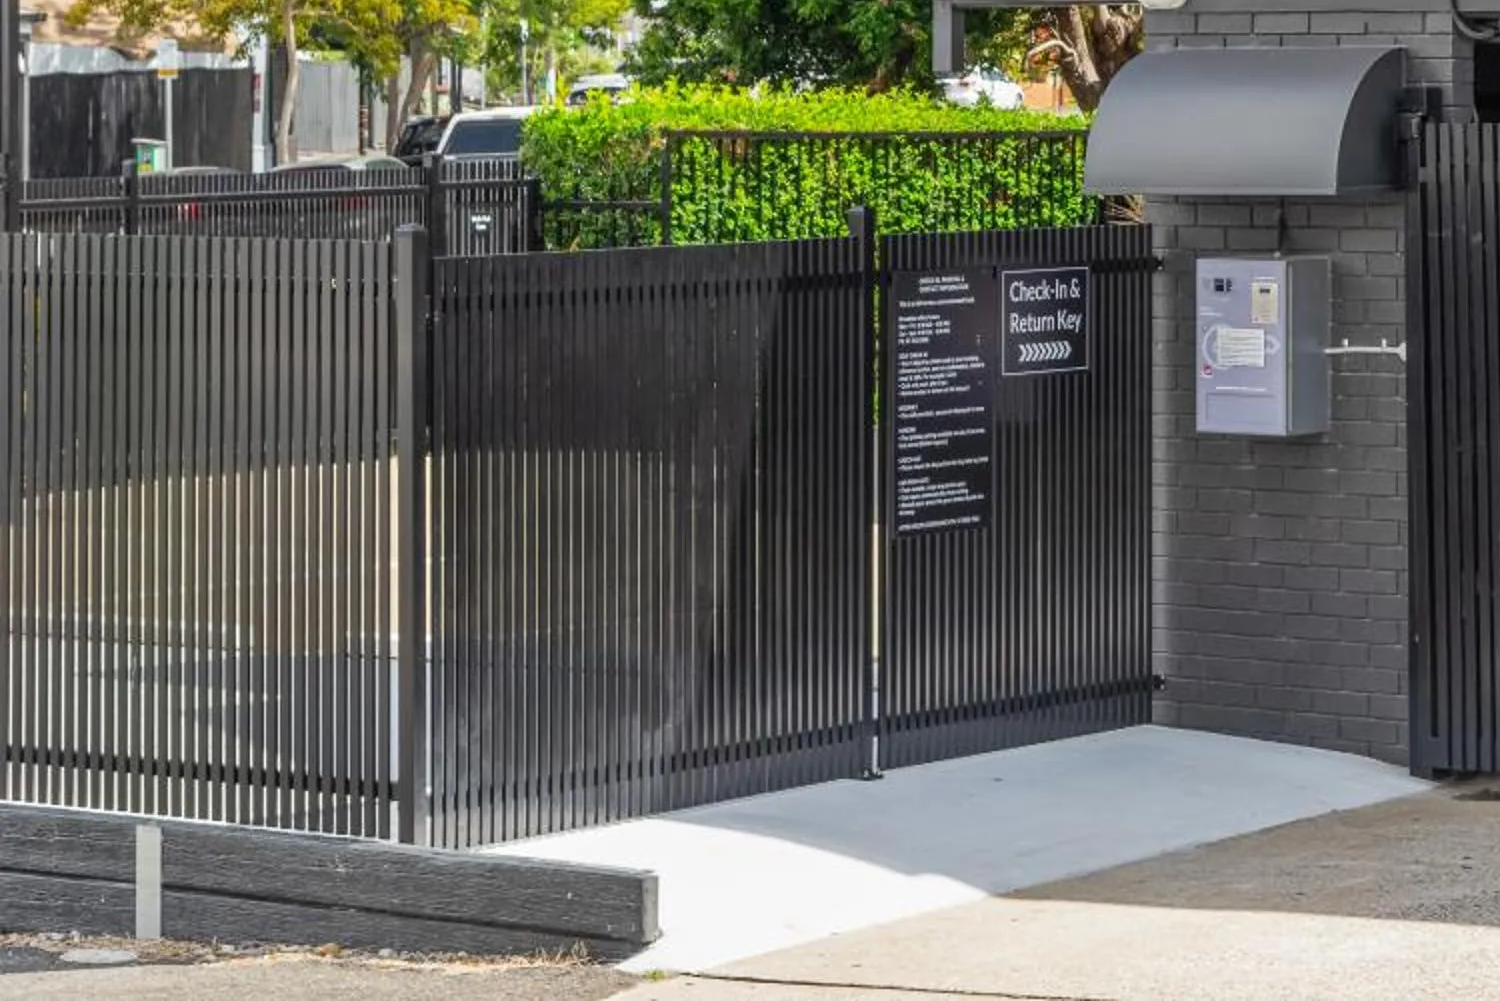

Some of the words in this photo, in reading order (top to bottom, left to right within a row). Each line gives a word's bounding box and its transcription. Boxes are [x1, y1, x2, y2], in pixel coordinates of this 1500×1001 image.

[1009, 279, 1068, 302] Check-In
[1070, 277, 1080, 298] &
[1010, 312, 1055, 334] Return
[1057, 308, 1082, 334] Key
